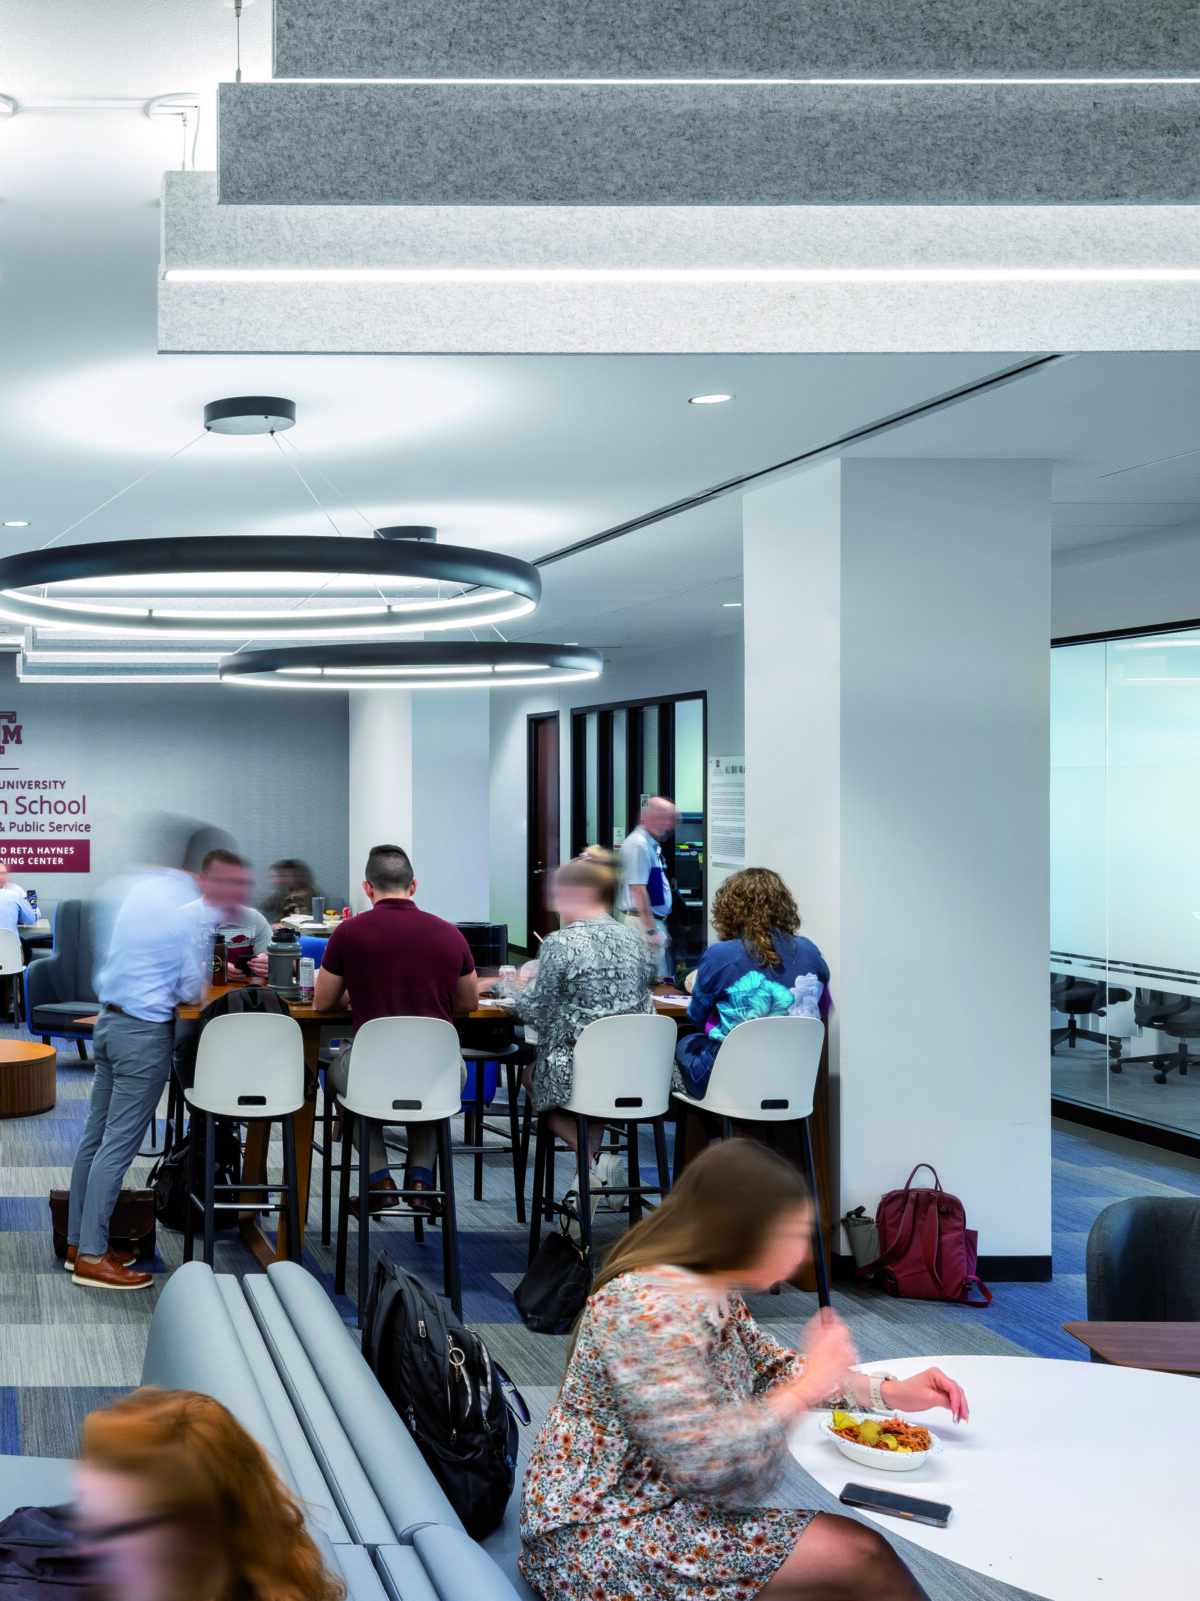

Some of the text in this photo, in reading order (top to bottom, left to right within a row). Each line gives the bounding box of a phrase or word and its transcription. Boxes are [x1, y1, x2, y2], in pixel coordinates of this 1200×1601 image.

[15, 794, 86, 815] School
[9, 821, 45, 832] Public
[48, 821, 91, 832] Service
[10, 847, 34, 855] RETA
[37, 847, 75, 855] HAYNES
[27, 857, 64, 865] CENTER
